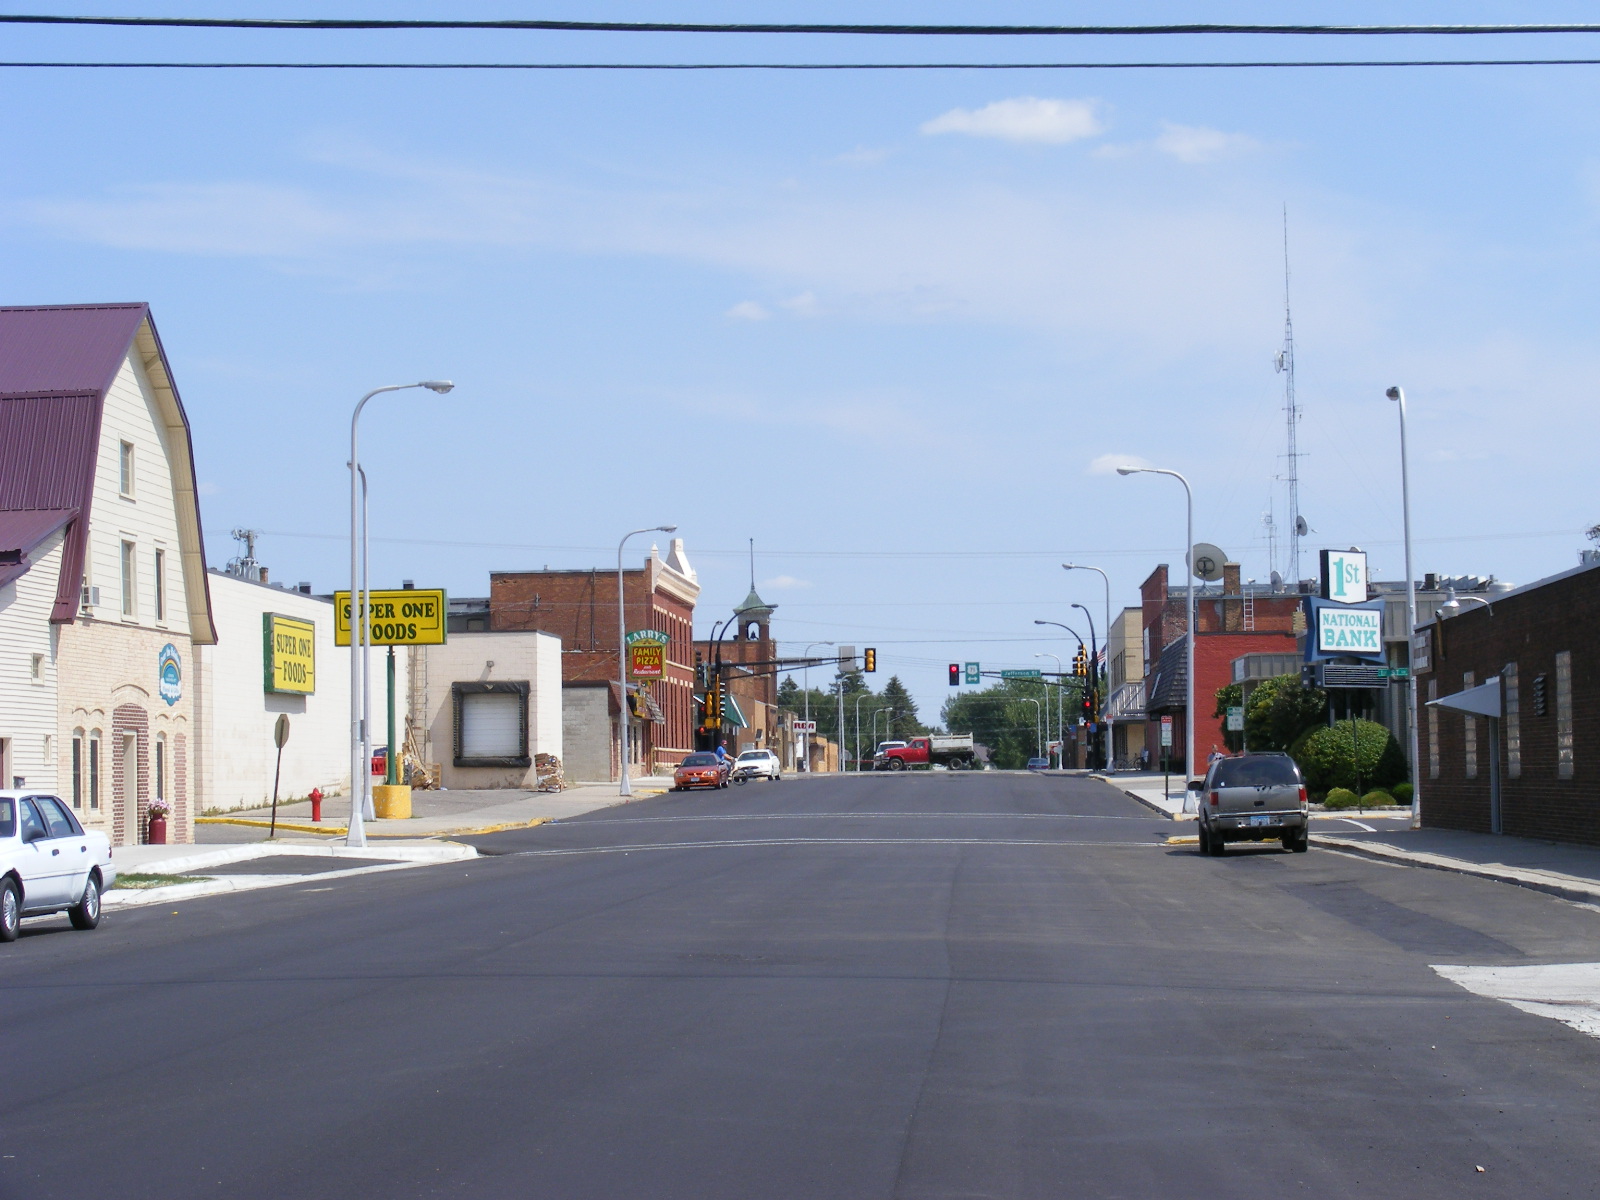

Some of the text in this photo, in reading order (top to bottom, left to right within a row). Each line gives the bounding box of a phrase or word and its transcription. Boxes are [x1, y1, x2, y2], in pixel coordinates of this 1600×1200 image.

[402, 602, 434, 618] ONE
[1322, 613, 1377, 628] NATIONAL
[362, 623, 417, 640] OODS
[1323, 628, 1377, 648] BANK
[276, 633, 311, 658] SUPER ONE
[633, 647, 661, 656] FAMILY
[636, 656, 659, 665] PIZZA
[283, 660, 307, 684] FOODS
